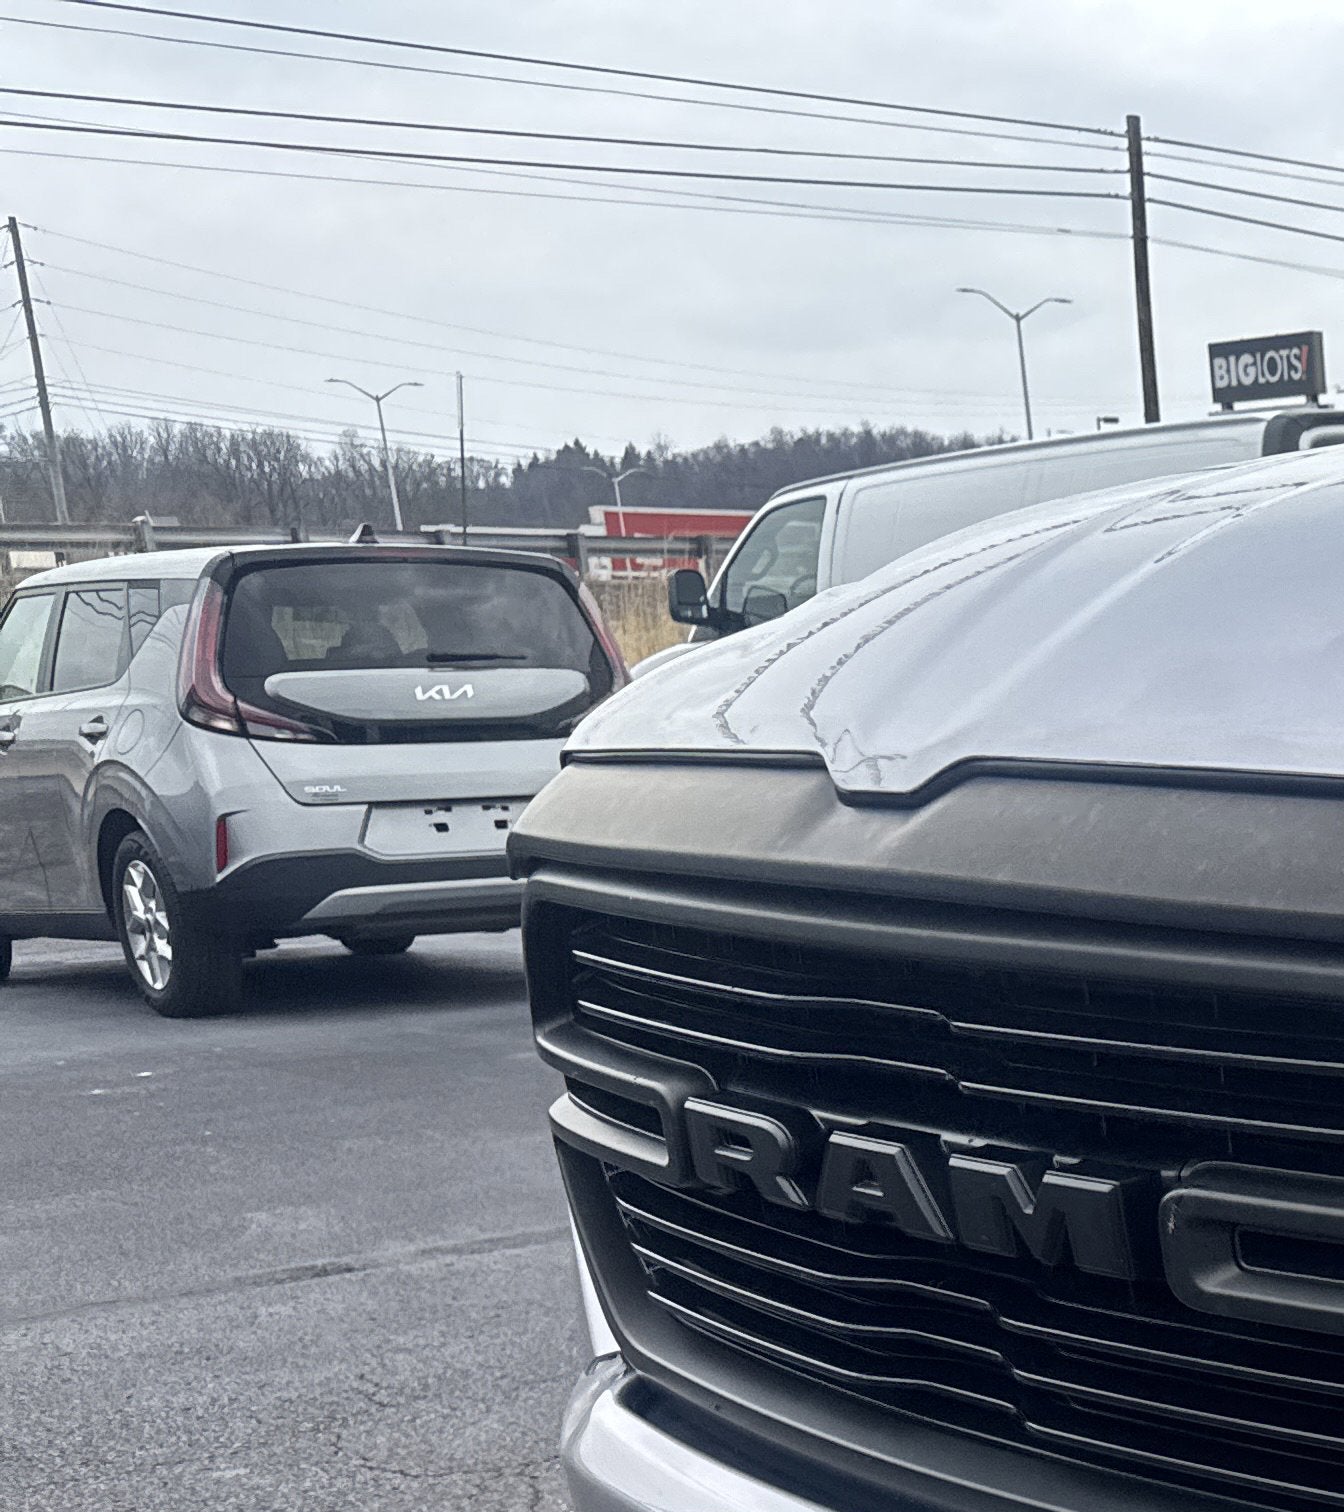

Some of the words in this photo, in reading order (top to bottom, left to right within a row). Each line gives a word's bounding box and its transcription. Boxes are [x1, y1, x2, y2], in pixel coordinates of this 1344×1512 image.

[414, 684, 475, 700] KIA
[304, 784, 346, 793] SOUL
[683, 1095, 1136, 1281] RAM
